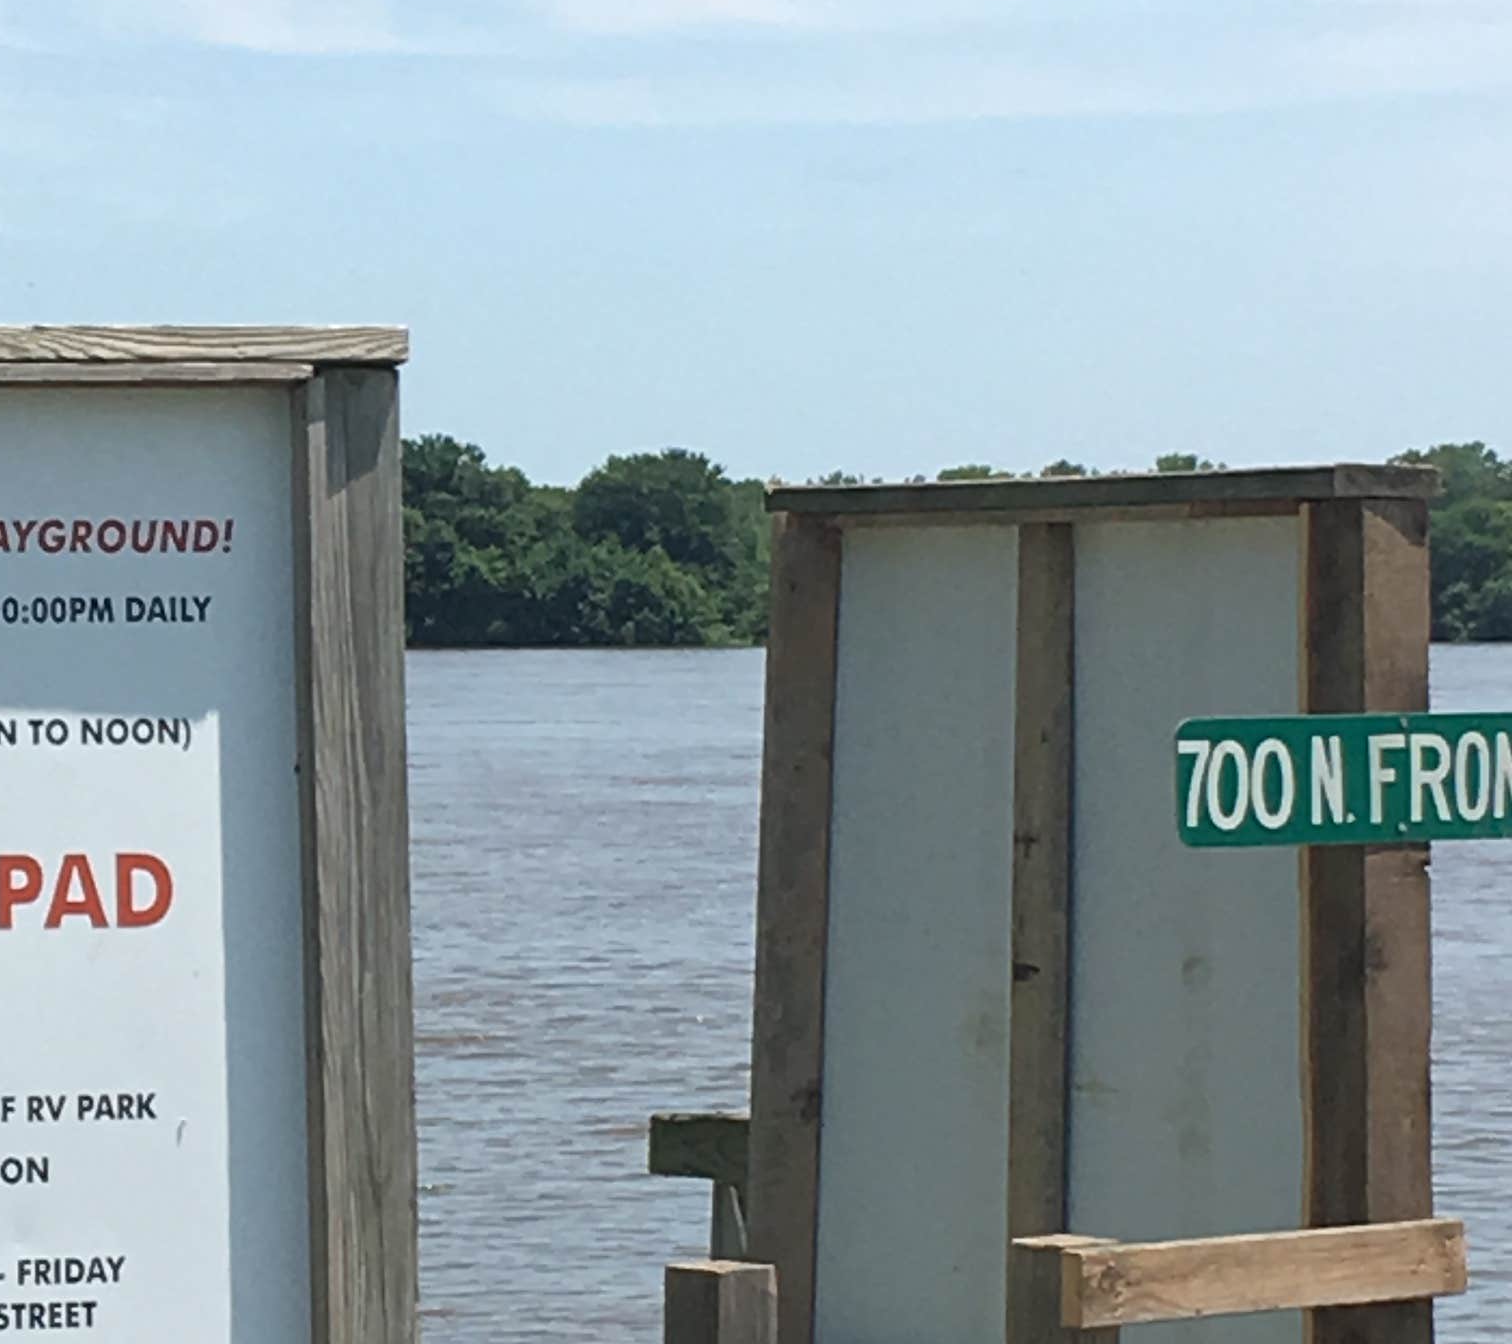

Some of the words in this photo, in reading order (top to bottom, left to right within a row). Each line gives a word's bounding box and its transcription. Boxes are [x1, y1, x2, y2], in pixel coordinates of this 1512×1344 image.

[125, 596, 212, 623] DAILY
[27, 718, 69, 746] TO
[81, 713, 191, 750] NOON)
[1177, 738, 1294, 830] 700
[1311, 735, 1356, 825] N.
[27, 1095, 66, 1122] RV
[77, 1093, 157, 1121] PARK
[17, 1256, 125, 1286] FRIDAY
